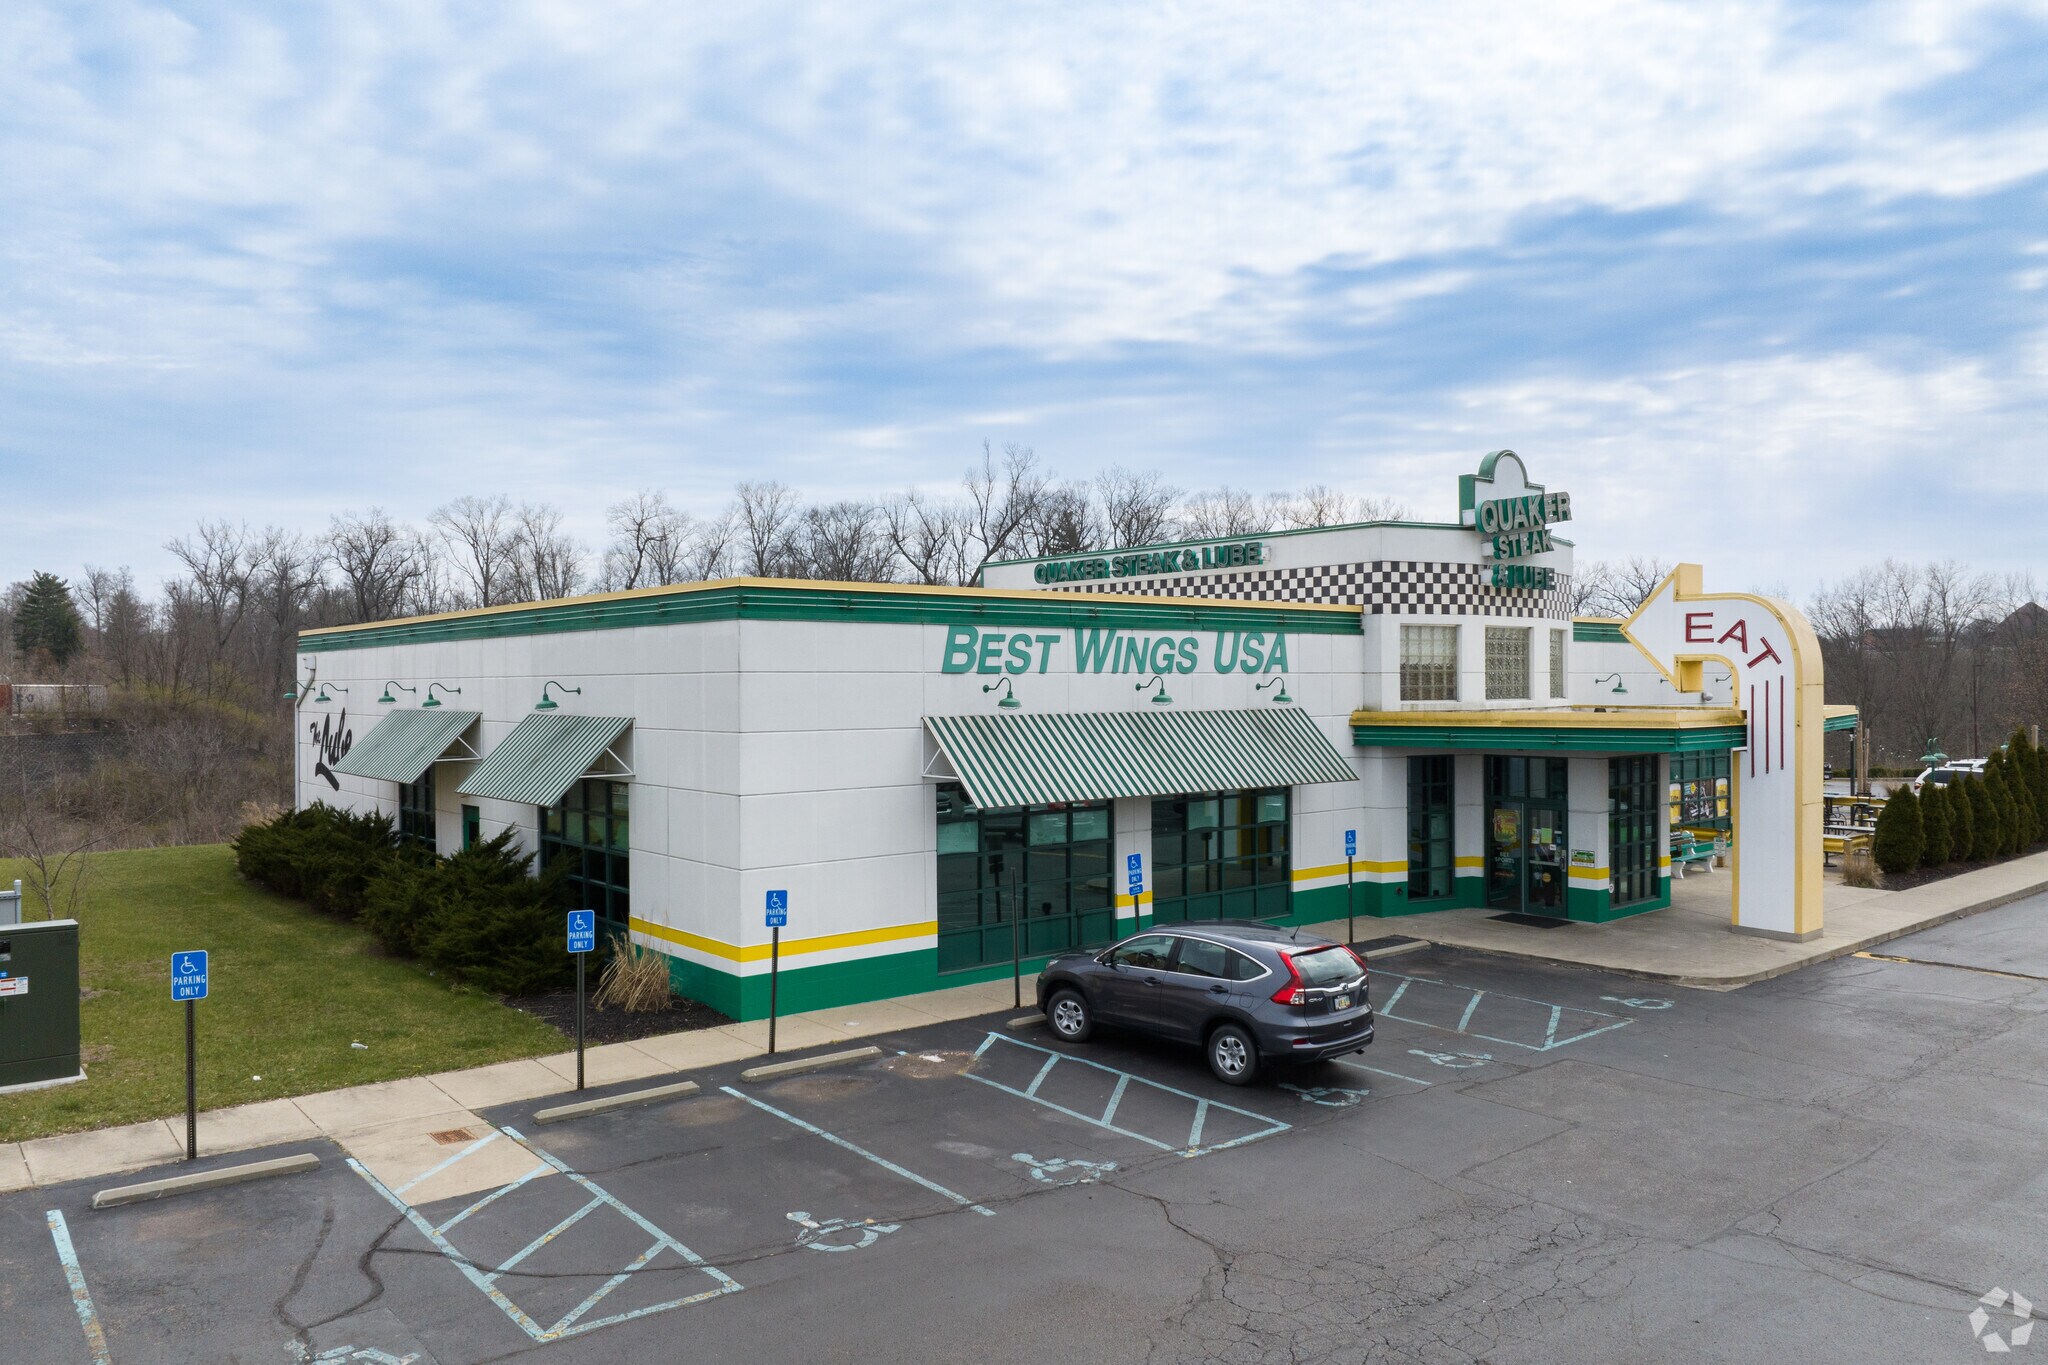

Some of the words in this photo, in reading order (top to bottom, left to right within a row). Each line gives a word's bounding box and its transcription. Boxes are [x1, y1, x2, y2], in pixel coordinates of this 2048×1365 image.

[1475, 491, 1572, 534] QUAKER
[1493, 529, 1555, 560] STEAK
[1034, 558, 1110, 584] QUAKER
[1112, 551, 1181, 578] STEAK
[1182, 549, 1199, 571] &
[1202, 542, 1263, 569] LUBE
[1491, 563, 1508, 587] &
[1510, 565, 1556, 590] LUBE
[941, 625, 1061, 674] BEST
[1074, 628, 1199, 674] WINGS
[1214, 632, 1289, 674] USA
[1686, 612, 1782, 669] EAT
[310, 720, 322, 747] The
[569, 931, 593, 939] PARKING
[573, 940, 588, 949] ONLY
[174, 974, 206, 986] PARKING
[180, 986, 200, 997] ONLY
